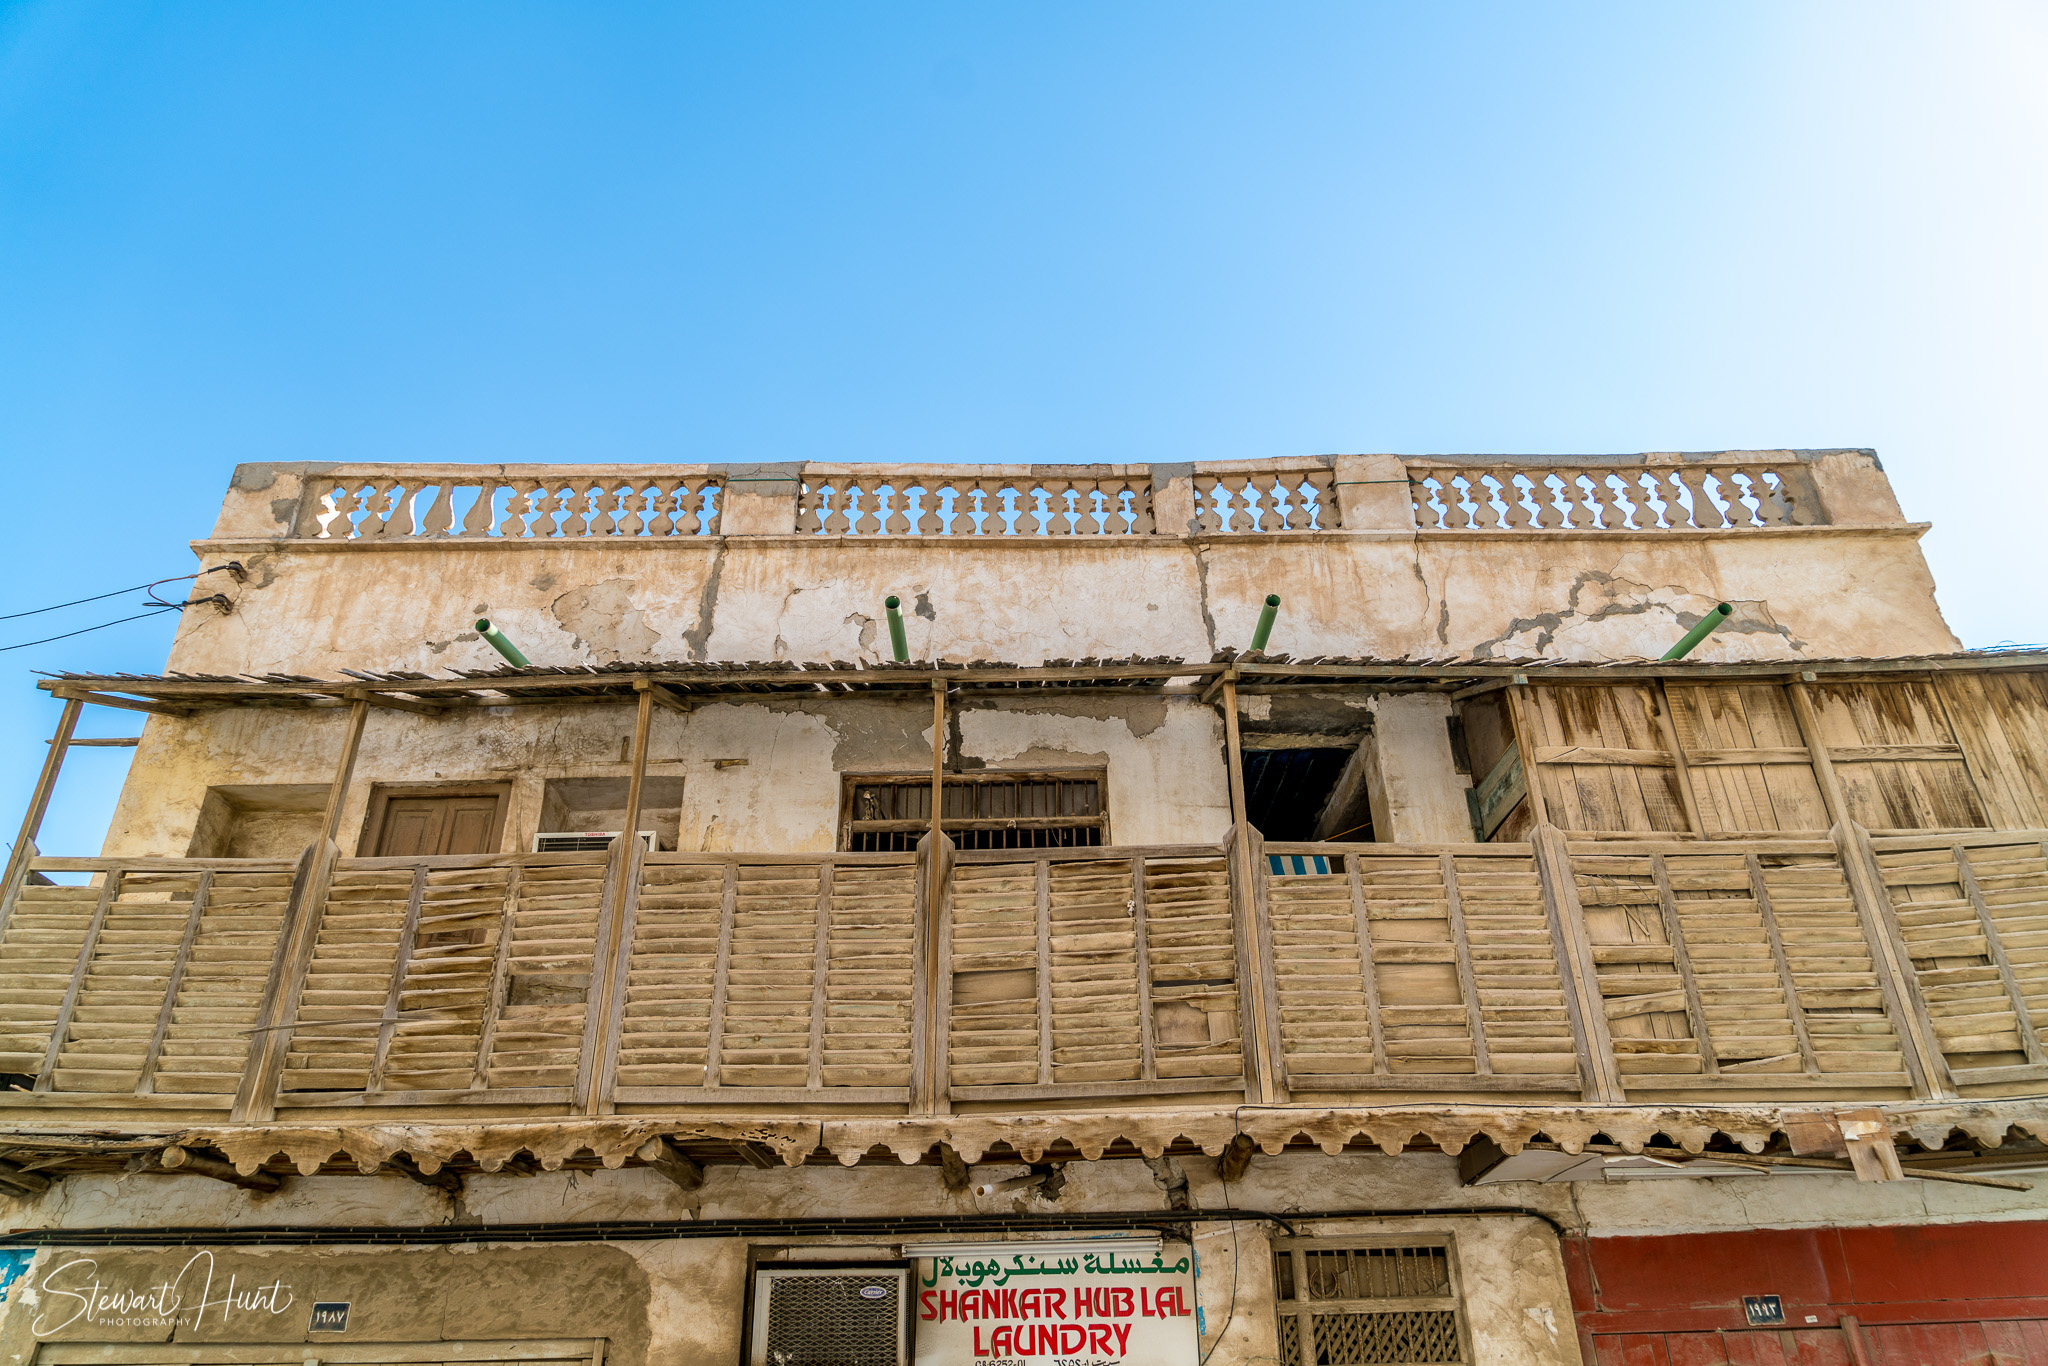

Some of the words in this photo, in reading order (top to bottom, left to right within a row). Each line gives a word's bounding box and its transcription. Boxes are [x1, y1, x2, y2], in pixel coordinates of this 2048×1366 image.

[1083, 1251, 1189, 1275] مغسلة
[316, 1311, 345, 1323] ١٩٨٧
[920, 1287, 1067, 1324] SHANKAR
[1075, 1287, 1135, 1320] HUB
[1141, 1286, 1192, 1320] LAL
[973, 1323, 1132, 1359] LAUNDRY
